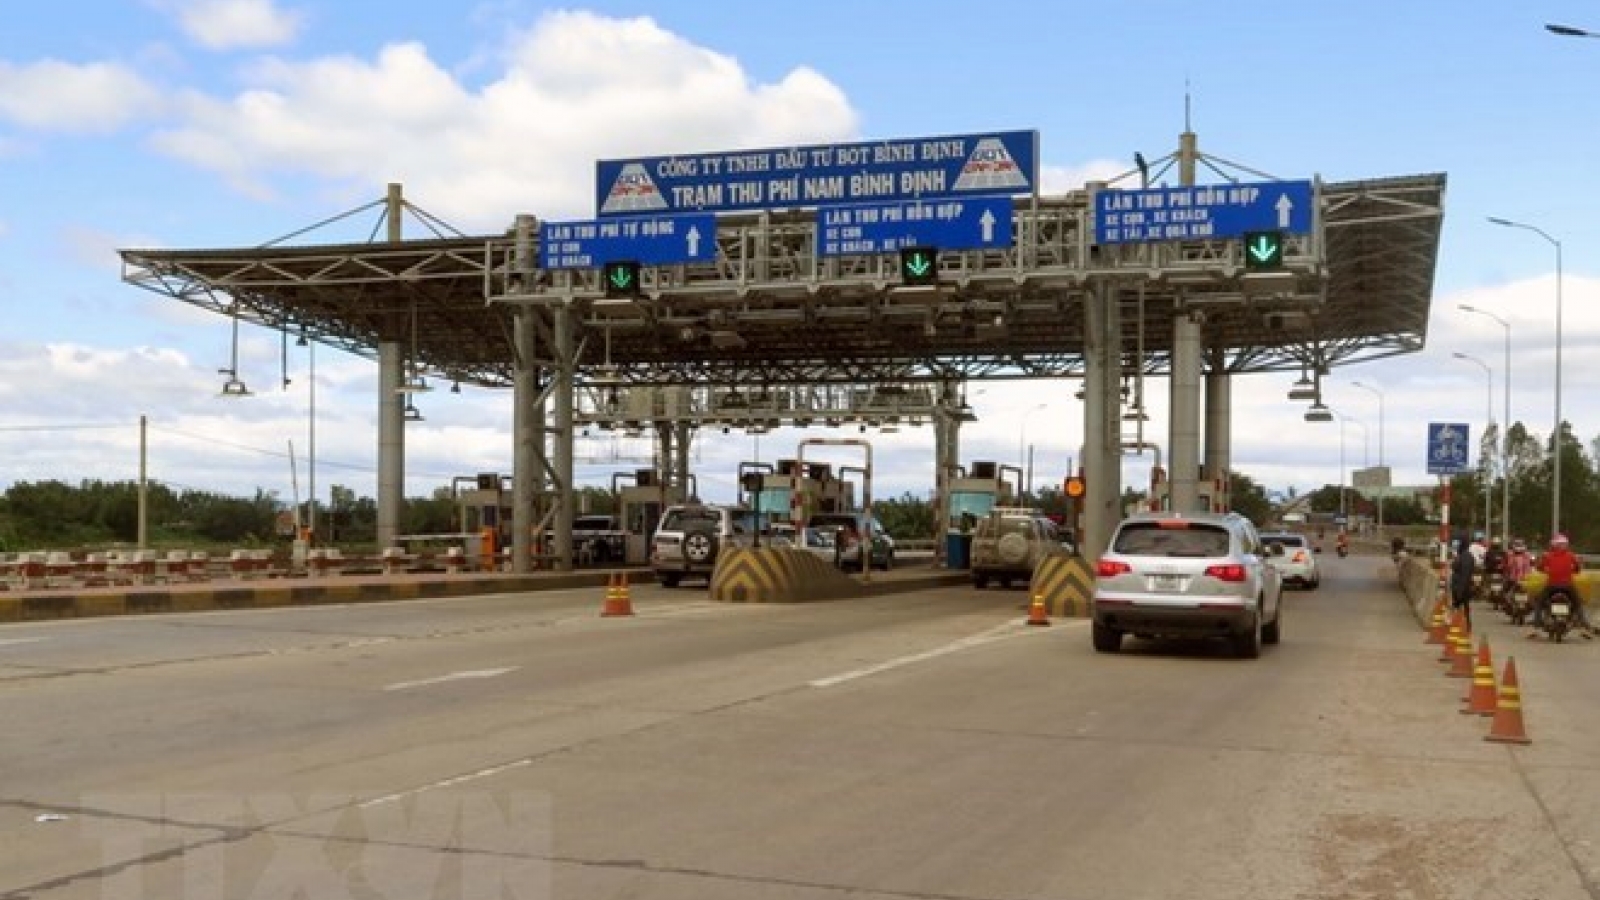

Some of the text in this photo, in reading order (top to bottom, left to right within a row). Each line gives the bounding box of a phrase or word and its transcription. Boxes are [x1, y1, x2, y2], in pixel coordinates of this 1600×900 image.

[656, 156, 698, 177] CÔNG
[702, 158, 722, 174] TY
[725, 153, 770, 172] TNHH
[776, 147, 807, 169] ĐẦU
[837, 147, 869, 165] BOT
[874, 140, 914, 164] BÌNH
[921, 140, 965, 161] ĐỊNH
[671, 184, 723, 210] TRẠM
[728, 180, 762, 204] THU
[768, 173, 801, 202] PHÍ
[805, 175, 844, 199] NAM
[850, 168, 895, 196] BÌNH
[901, 170, 946, 198] ĐỊNH
[1137, 194, 1163, 209] THU
[1170, 187, 1192, 207] PHÍ
[855, 209, 879, 223] THU
[882, 203, 902, 221] PHÍ
[574, 226, 597, 239] THU
[600, 219, 619, 238] PHÍ
